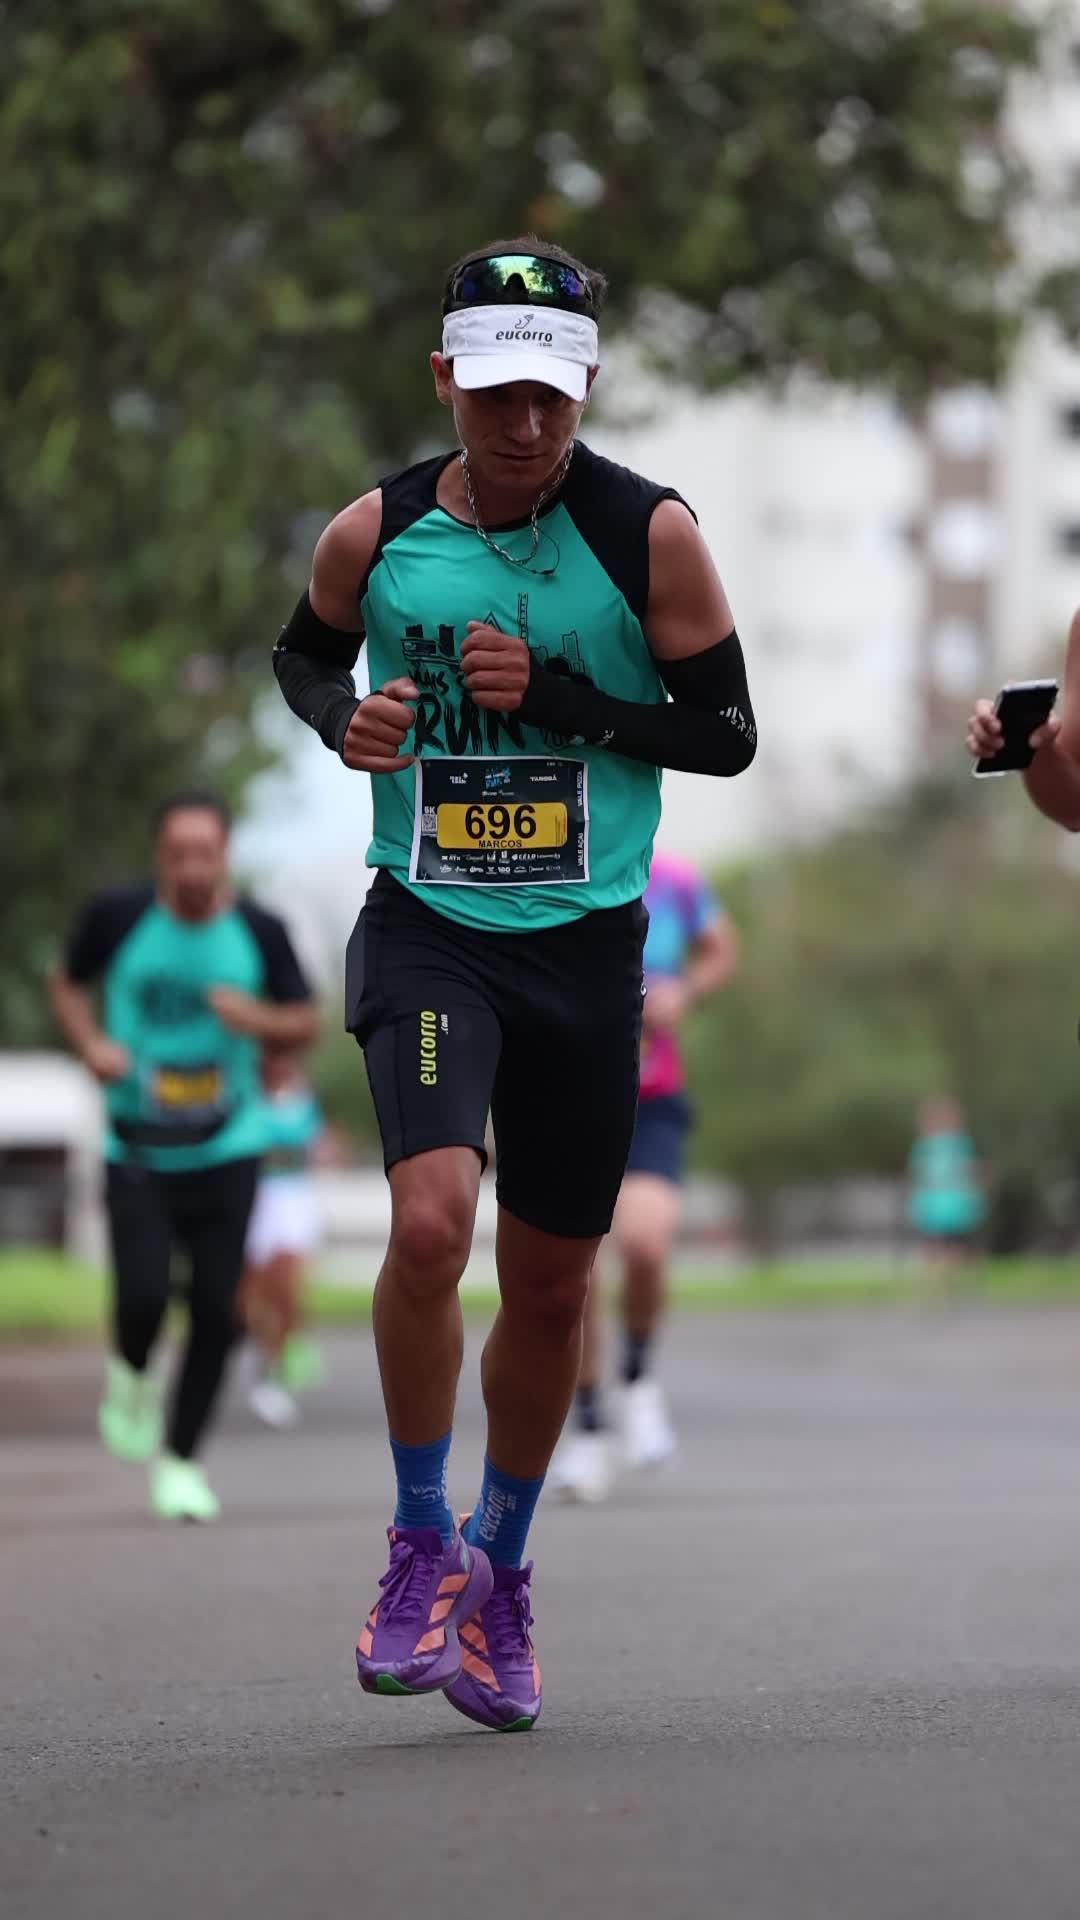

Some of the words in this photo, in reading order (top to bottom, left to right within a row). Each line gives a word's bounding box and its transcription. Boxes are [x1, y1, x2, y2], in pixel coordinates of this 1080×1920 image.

[495, 330, 553, 342] eucorro
[414, 692, 527, 757] RUN
[465, 804, 537, 840] 696
[478, 840, 523, 849] MARCOS
[420, 1010, 437, 1085] eucorro
